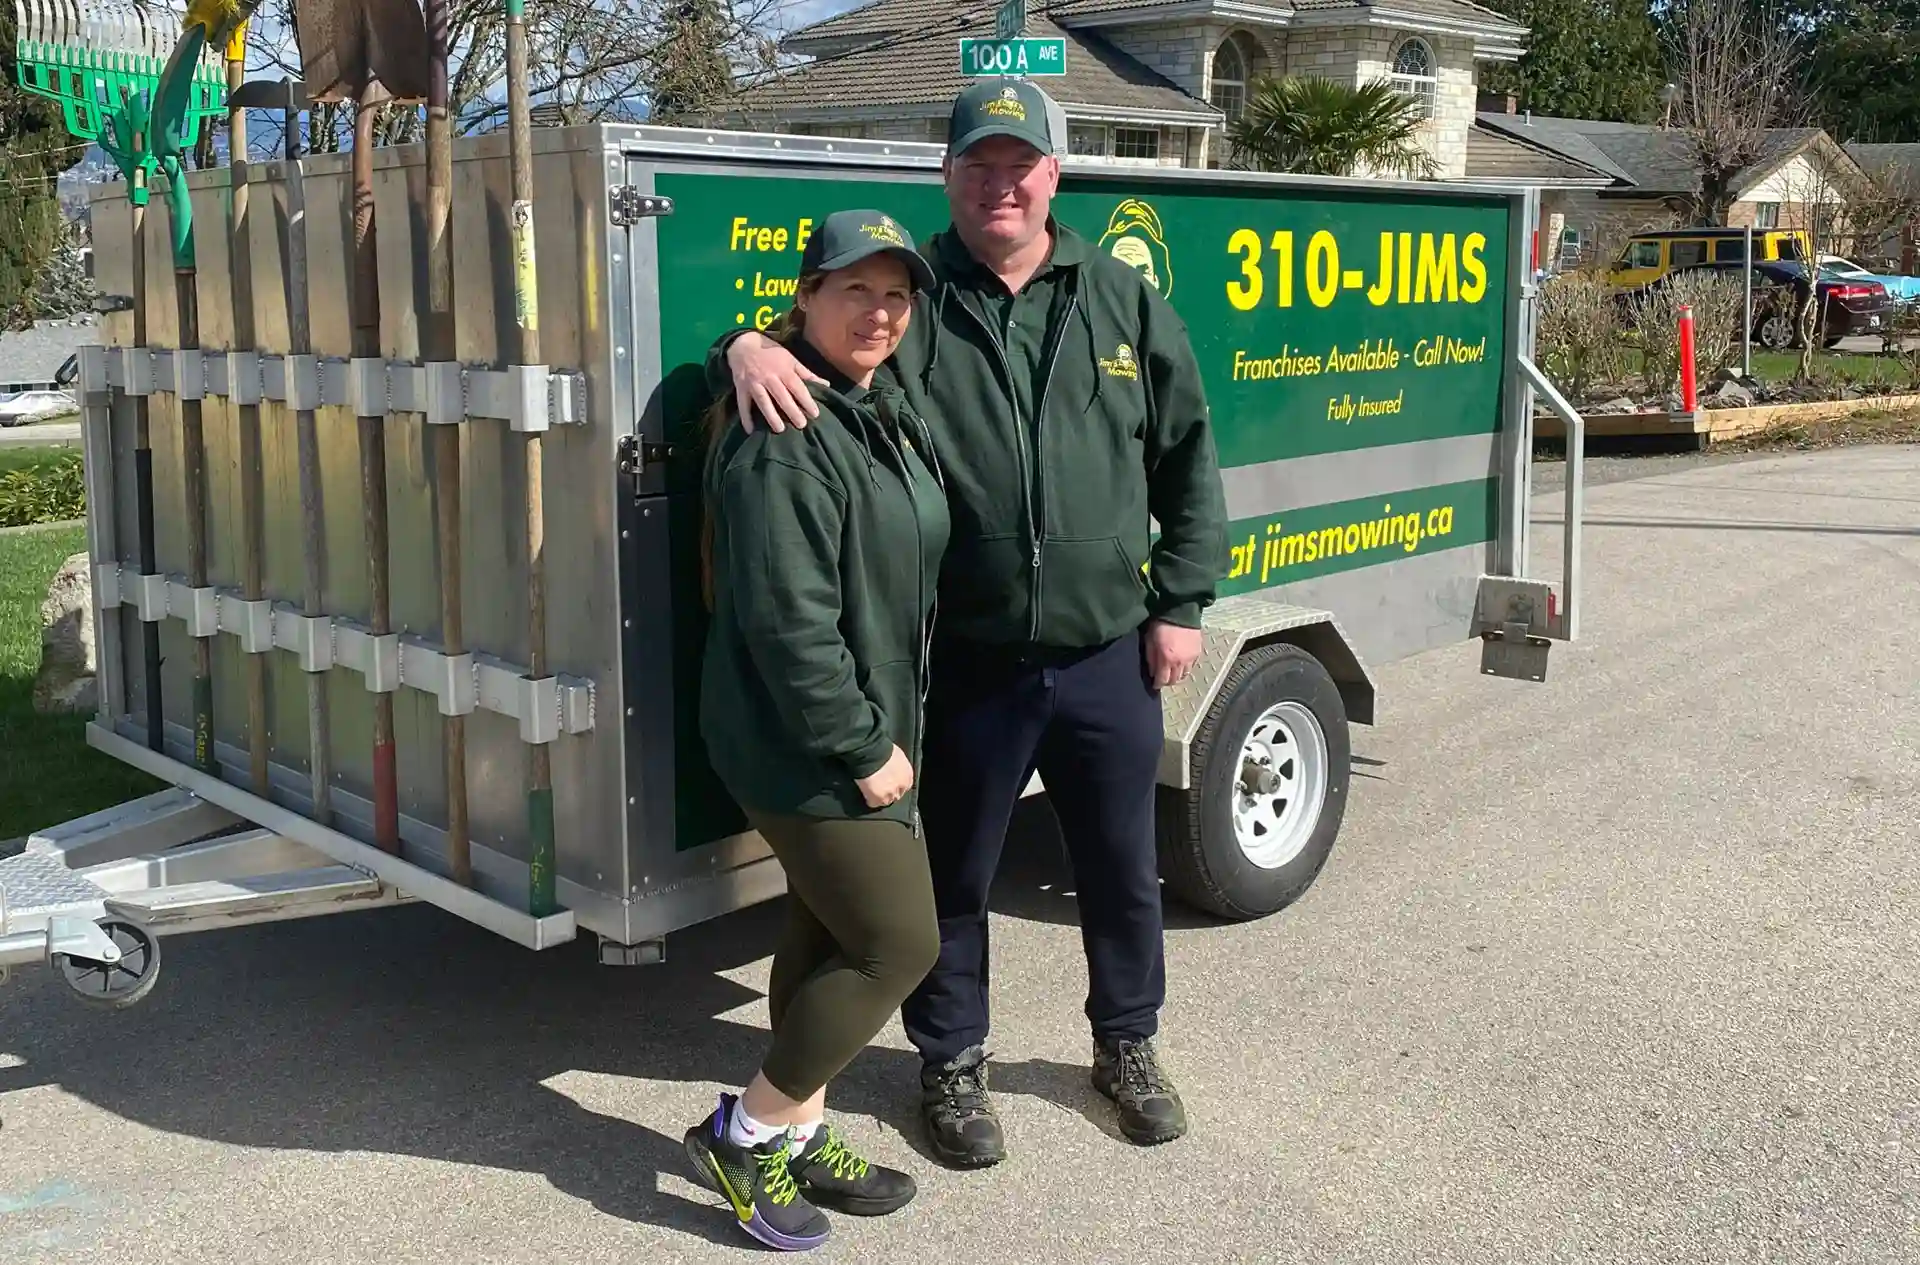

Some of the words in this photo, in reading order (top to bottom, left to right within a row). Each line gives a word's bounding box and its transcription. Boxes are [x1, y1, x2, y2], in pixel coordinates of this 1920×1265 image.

[968, 44, 1012, 70] 100
[1016, 44, 1029, 70] A
[1038, 45, 1059, 61] AVE
[989, 107, 1026, 121] Mowing
[731, 217, 788, 252] Free
[753, 272, 799, 297] Law
[1226, 228, 1487, 311] 310-JIMS
[1107, 367, 1138, 381] Mowing
[1233, 343, 1321, 381] Franchises
[1324, 337, 1400, 374] Available
[1414, 335, 1444, 367] Call
[1445, 336, 1486, 364] Now!
[1327, 393, 1356, 425] Fully
[1358, 388, 1403, 416] Insured
[1228, 534, 1256, 578] at
[1261, 504, 1454, 583] jimsmowing.ca
